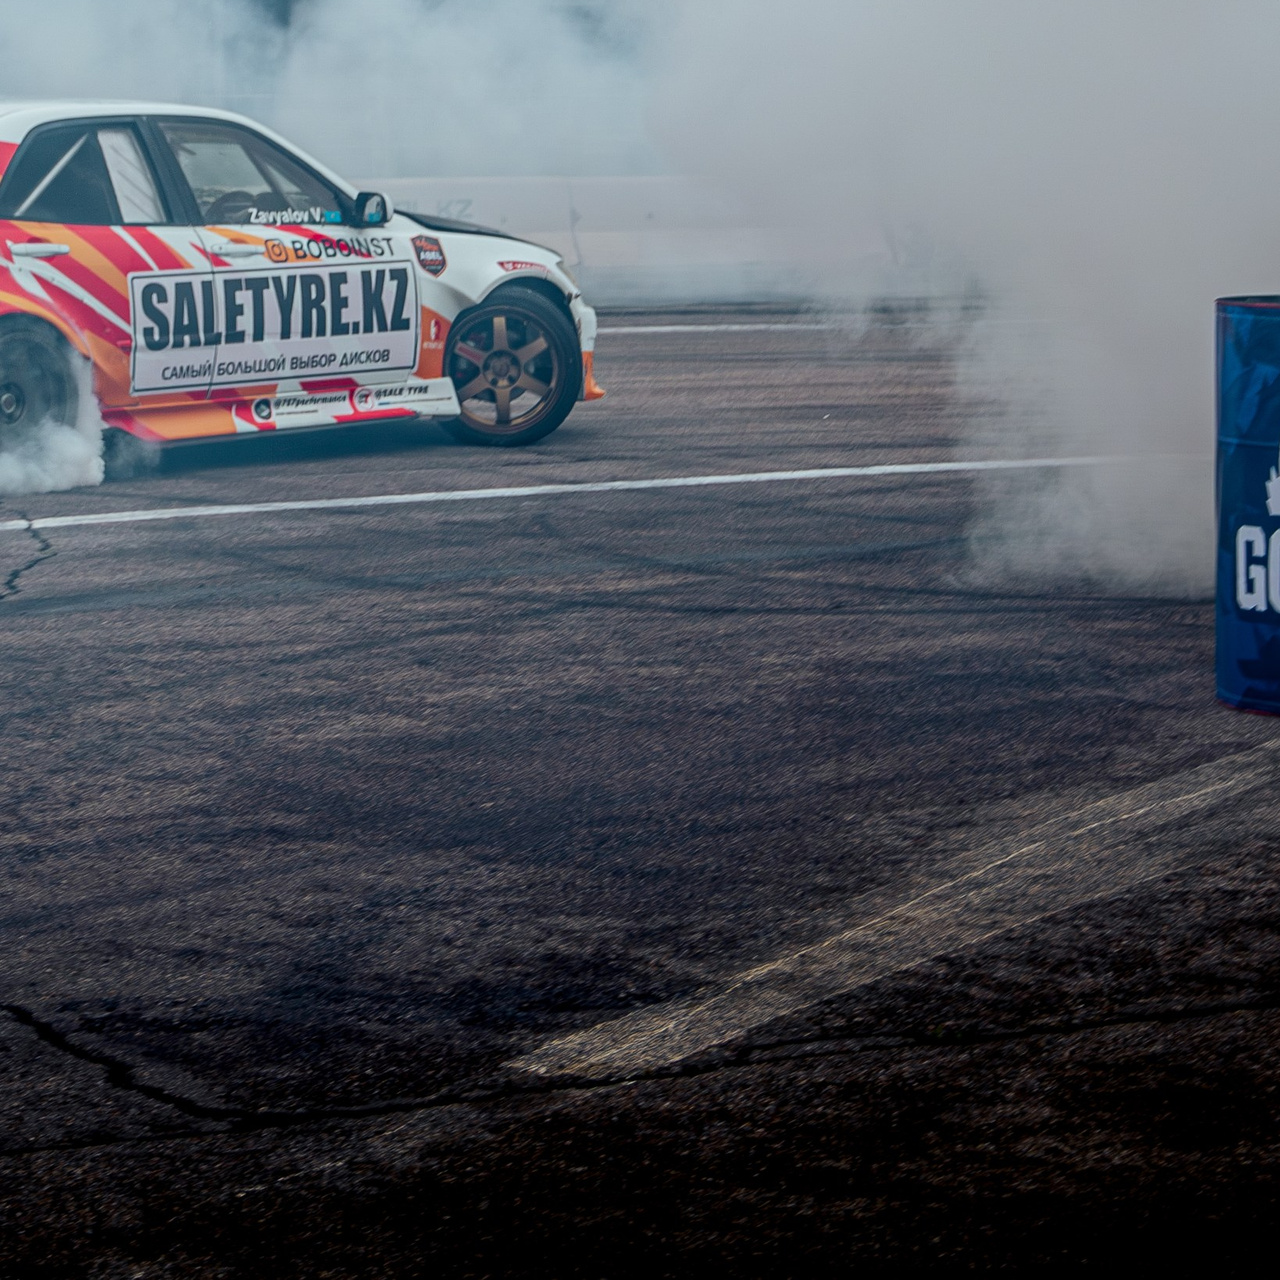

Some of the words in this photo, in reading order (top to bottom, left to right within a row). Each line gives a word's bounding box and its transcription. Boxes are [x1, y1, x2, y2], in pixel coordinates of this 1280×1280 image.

[248, 207, 309, 225] Zavyalov
[292, 237, 394, 259] BOBOINST
[141, 267, 411, 352] SALETYRE.KZ
[161, 359, 212, 380] САМЫЙ
[217, 352, 286, 376] БОЛЬШОЙ
[290, 352, 337, 370] ВЫБОР
[340, 347, 390, 368] ДИСКОВ
